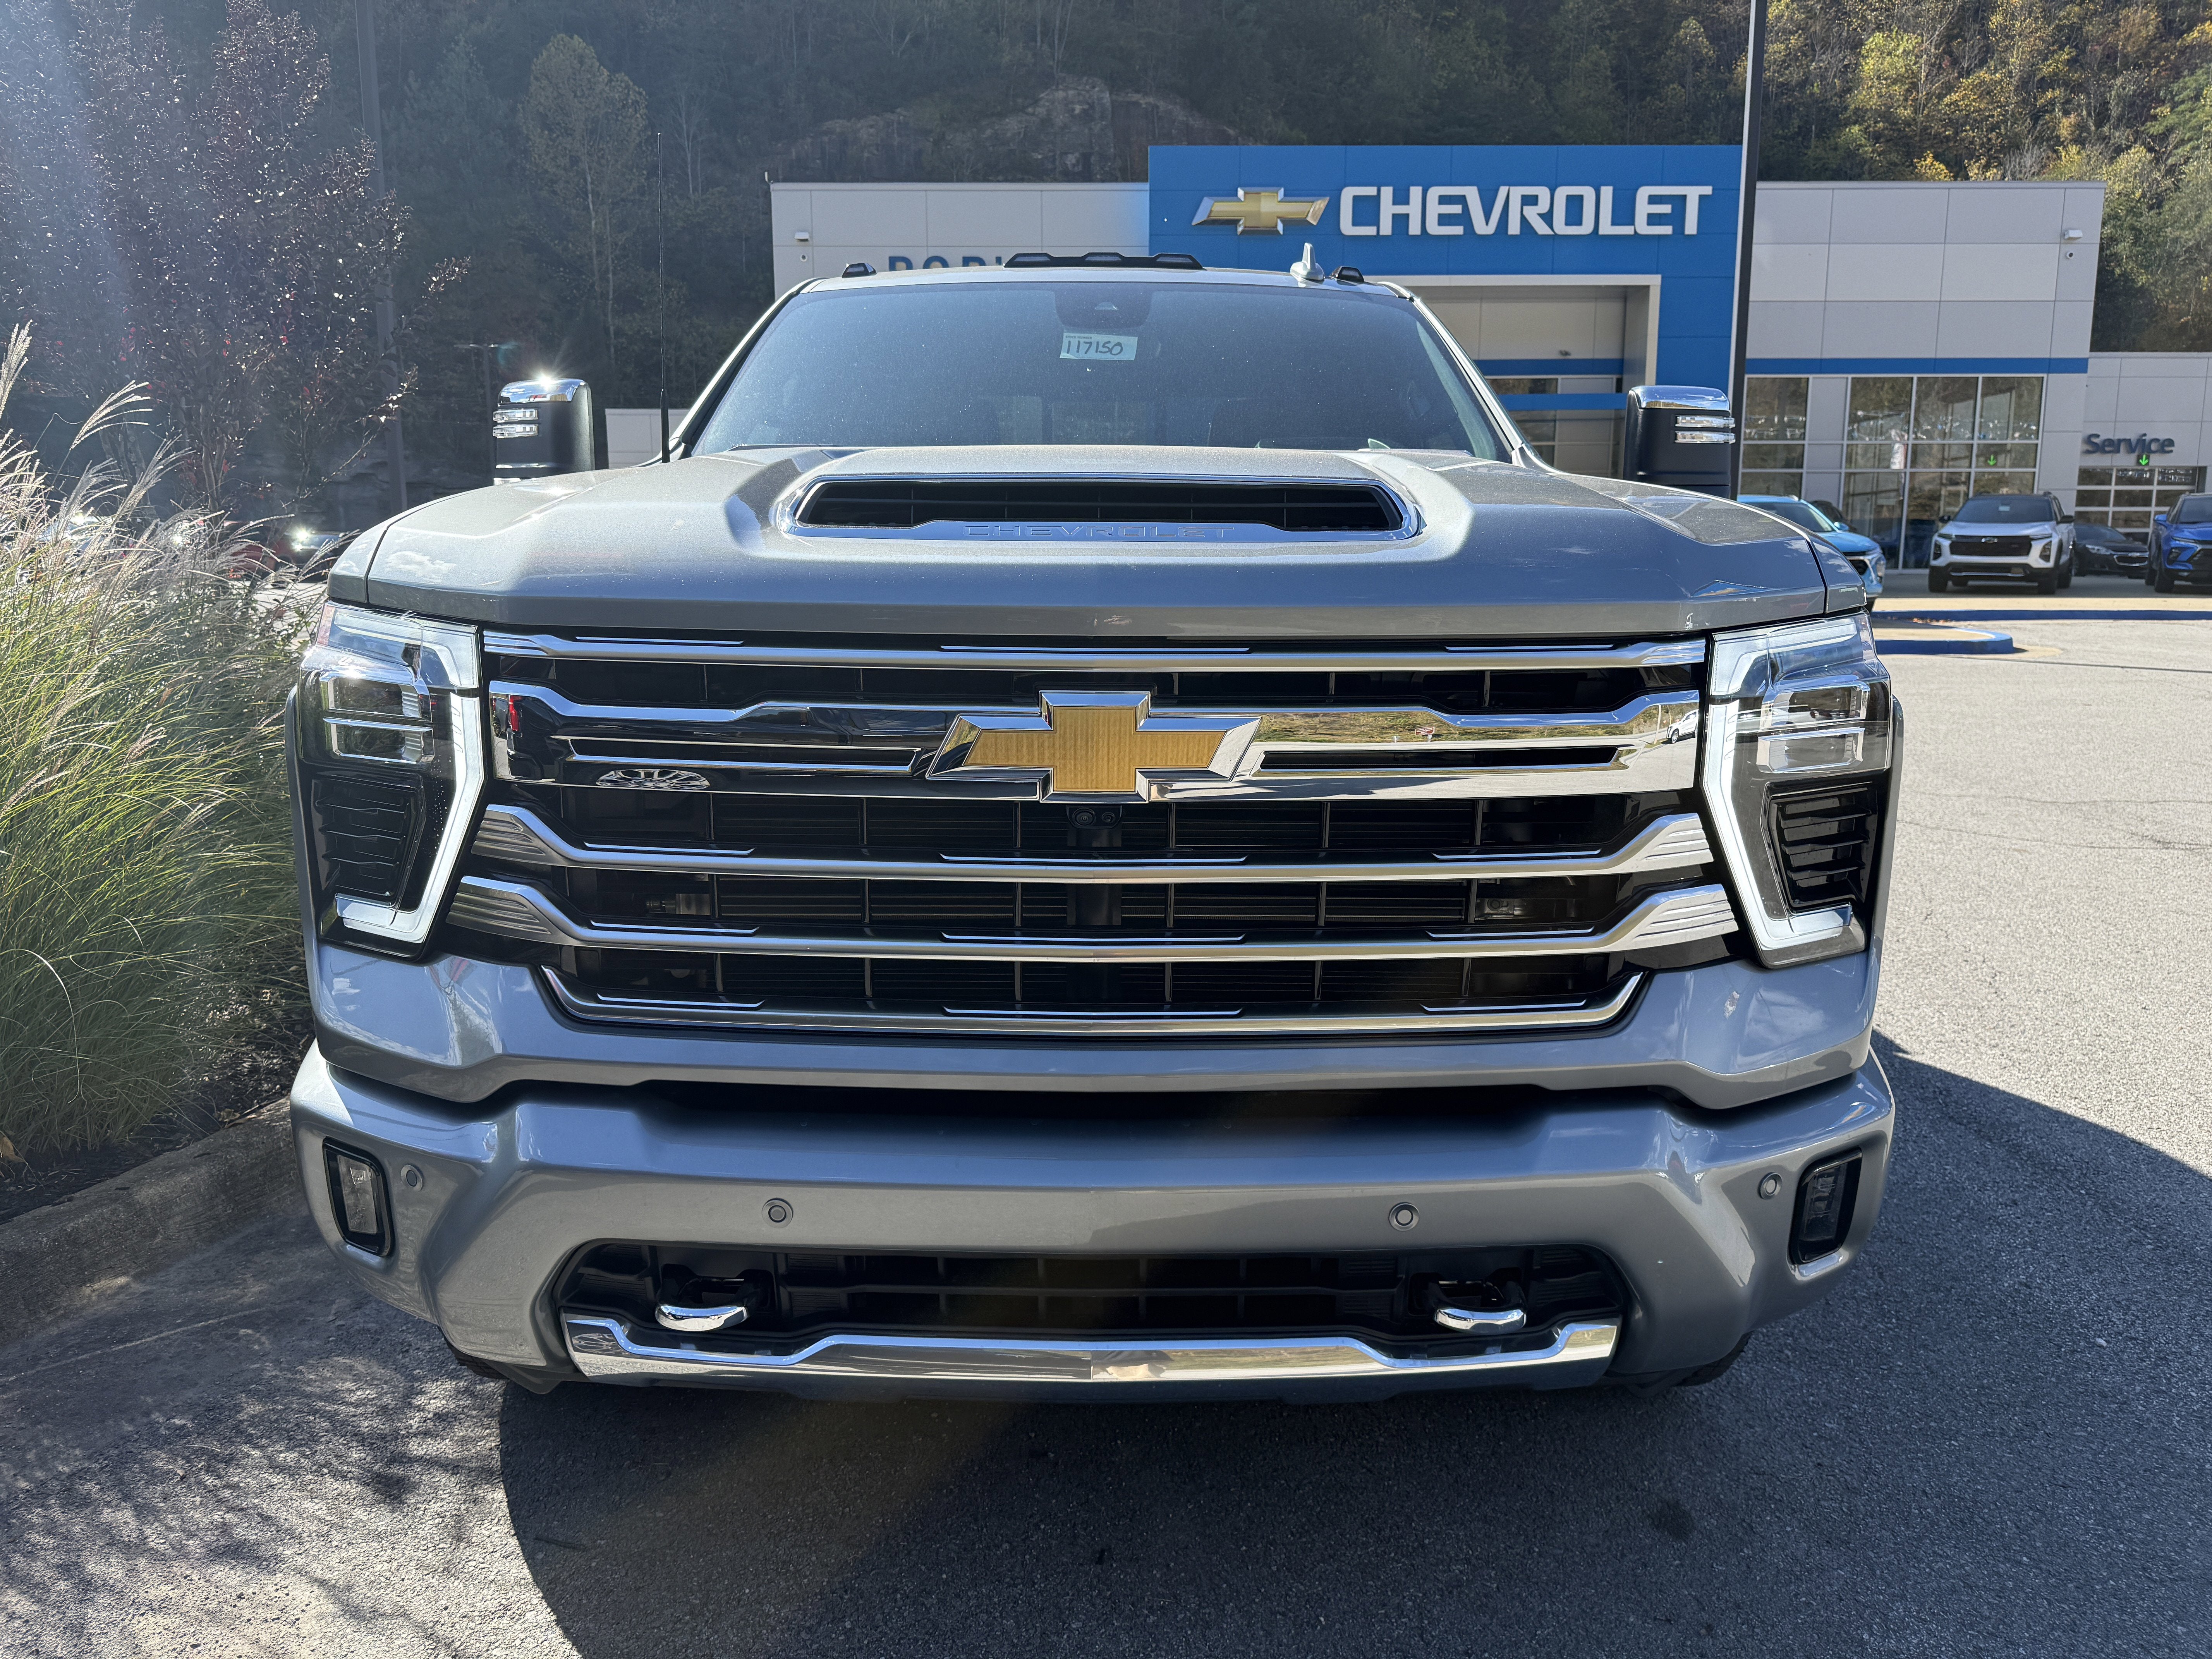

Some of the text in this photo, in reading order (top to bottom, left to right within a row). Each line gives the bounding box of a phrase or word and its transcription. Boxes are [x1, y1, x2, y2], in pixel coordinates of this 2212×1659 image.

[1339, 185, 1713, 236] CHEVROLET
[1066, 340, 1123, 356] 117150
[2083, 433, 2175, 454] Service
[963, 525, 1235, 538] CHEVROLET
